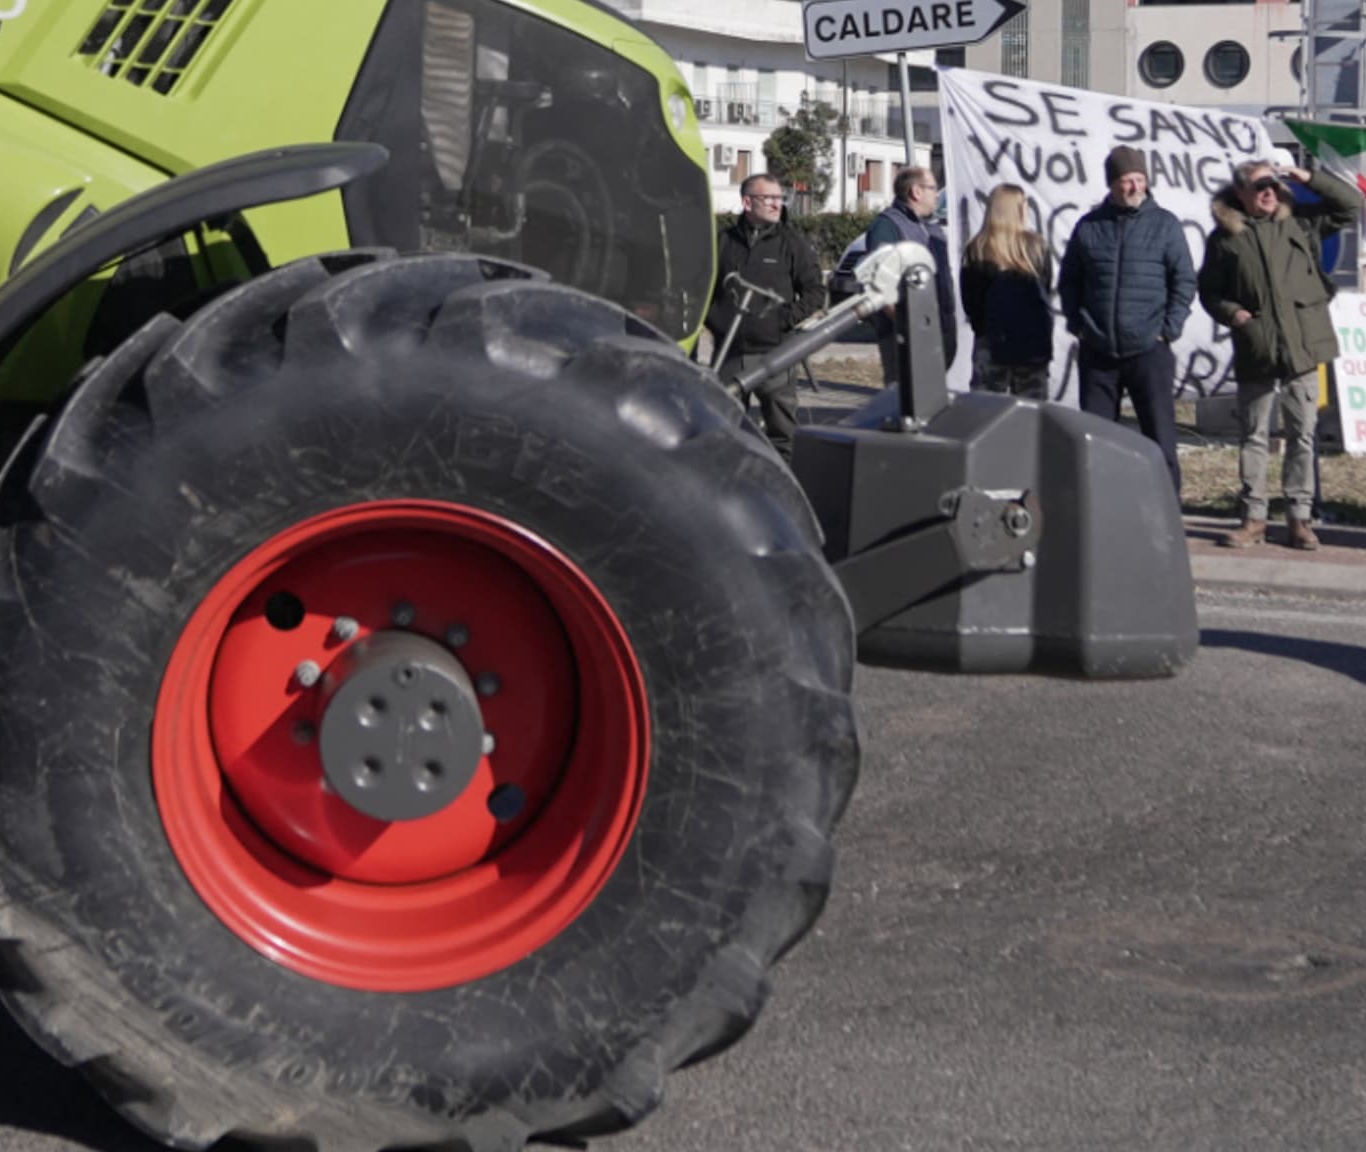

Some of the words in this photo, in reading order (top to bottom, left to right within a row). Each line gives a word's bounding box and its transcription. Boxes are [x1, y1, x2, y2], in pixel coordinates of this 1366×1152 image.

[813, 0, 976, 44] CALDARE
[982, 79, 1088, 137] SE
[1108, 102, 1257, 154] SANO
